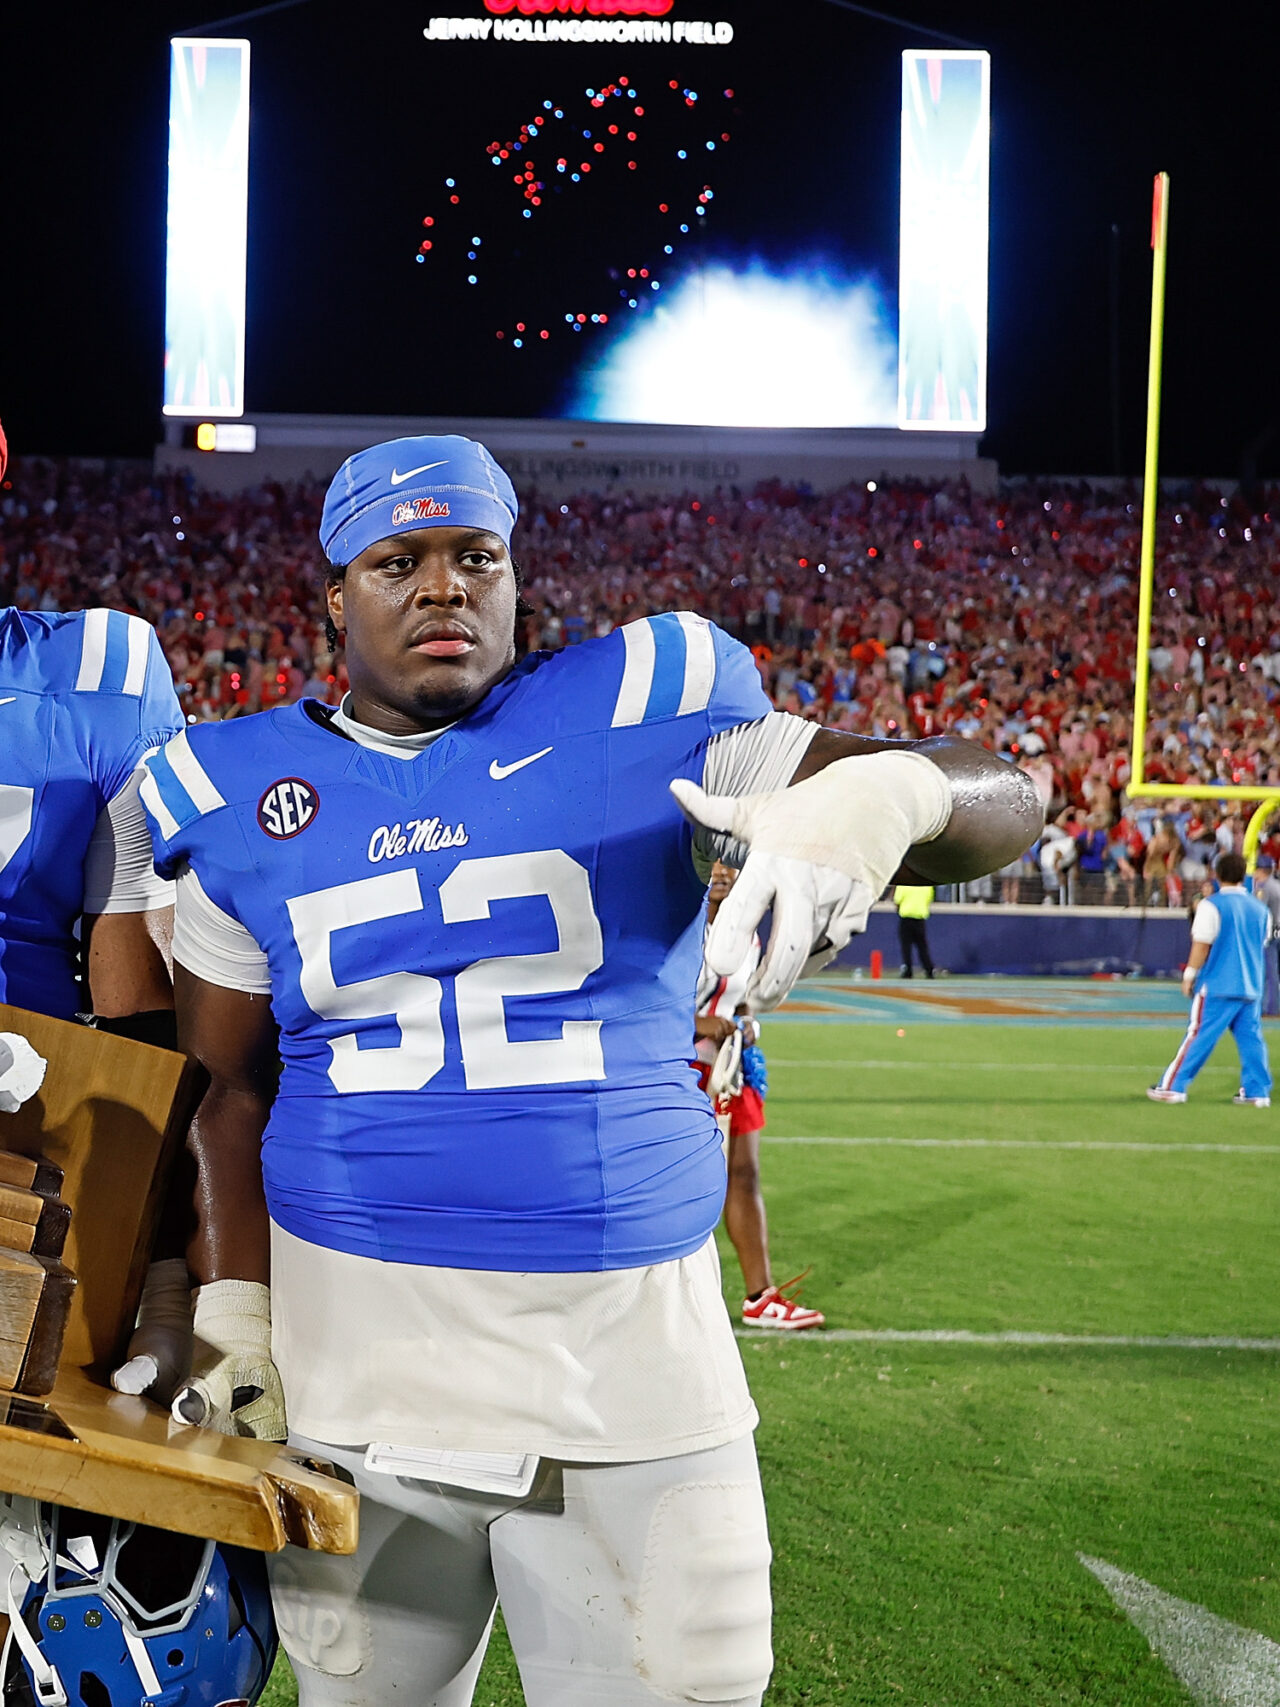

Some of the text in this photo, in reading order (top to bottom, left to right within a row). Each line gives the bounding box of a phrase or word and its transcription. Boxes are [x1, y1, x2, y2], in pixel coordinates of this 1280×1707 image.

[423, 17, 734, 44] JERRY HOLLINGSWORTH FIELD
[414, 497, 451, 518] Miss
[261, 781, 315, 836] SEC
[368, 816, 468, 863] Ole Miss
[285, 848, 607, 1094] 52
